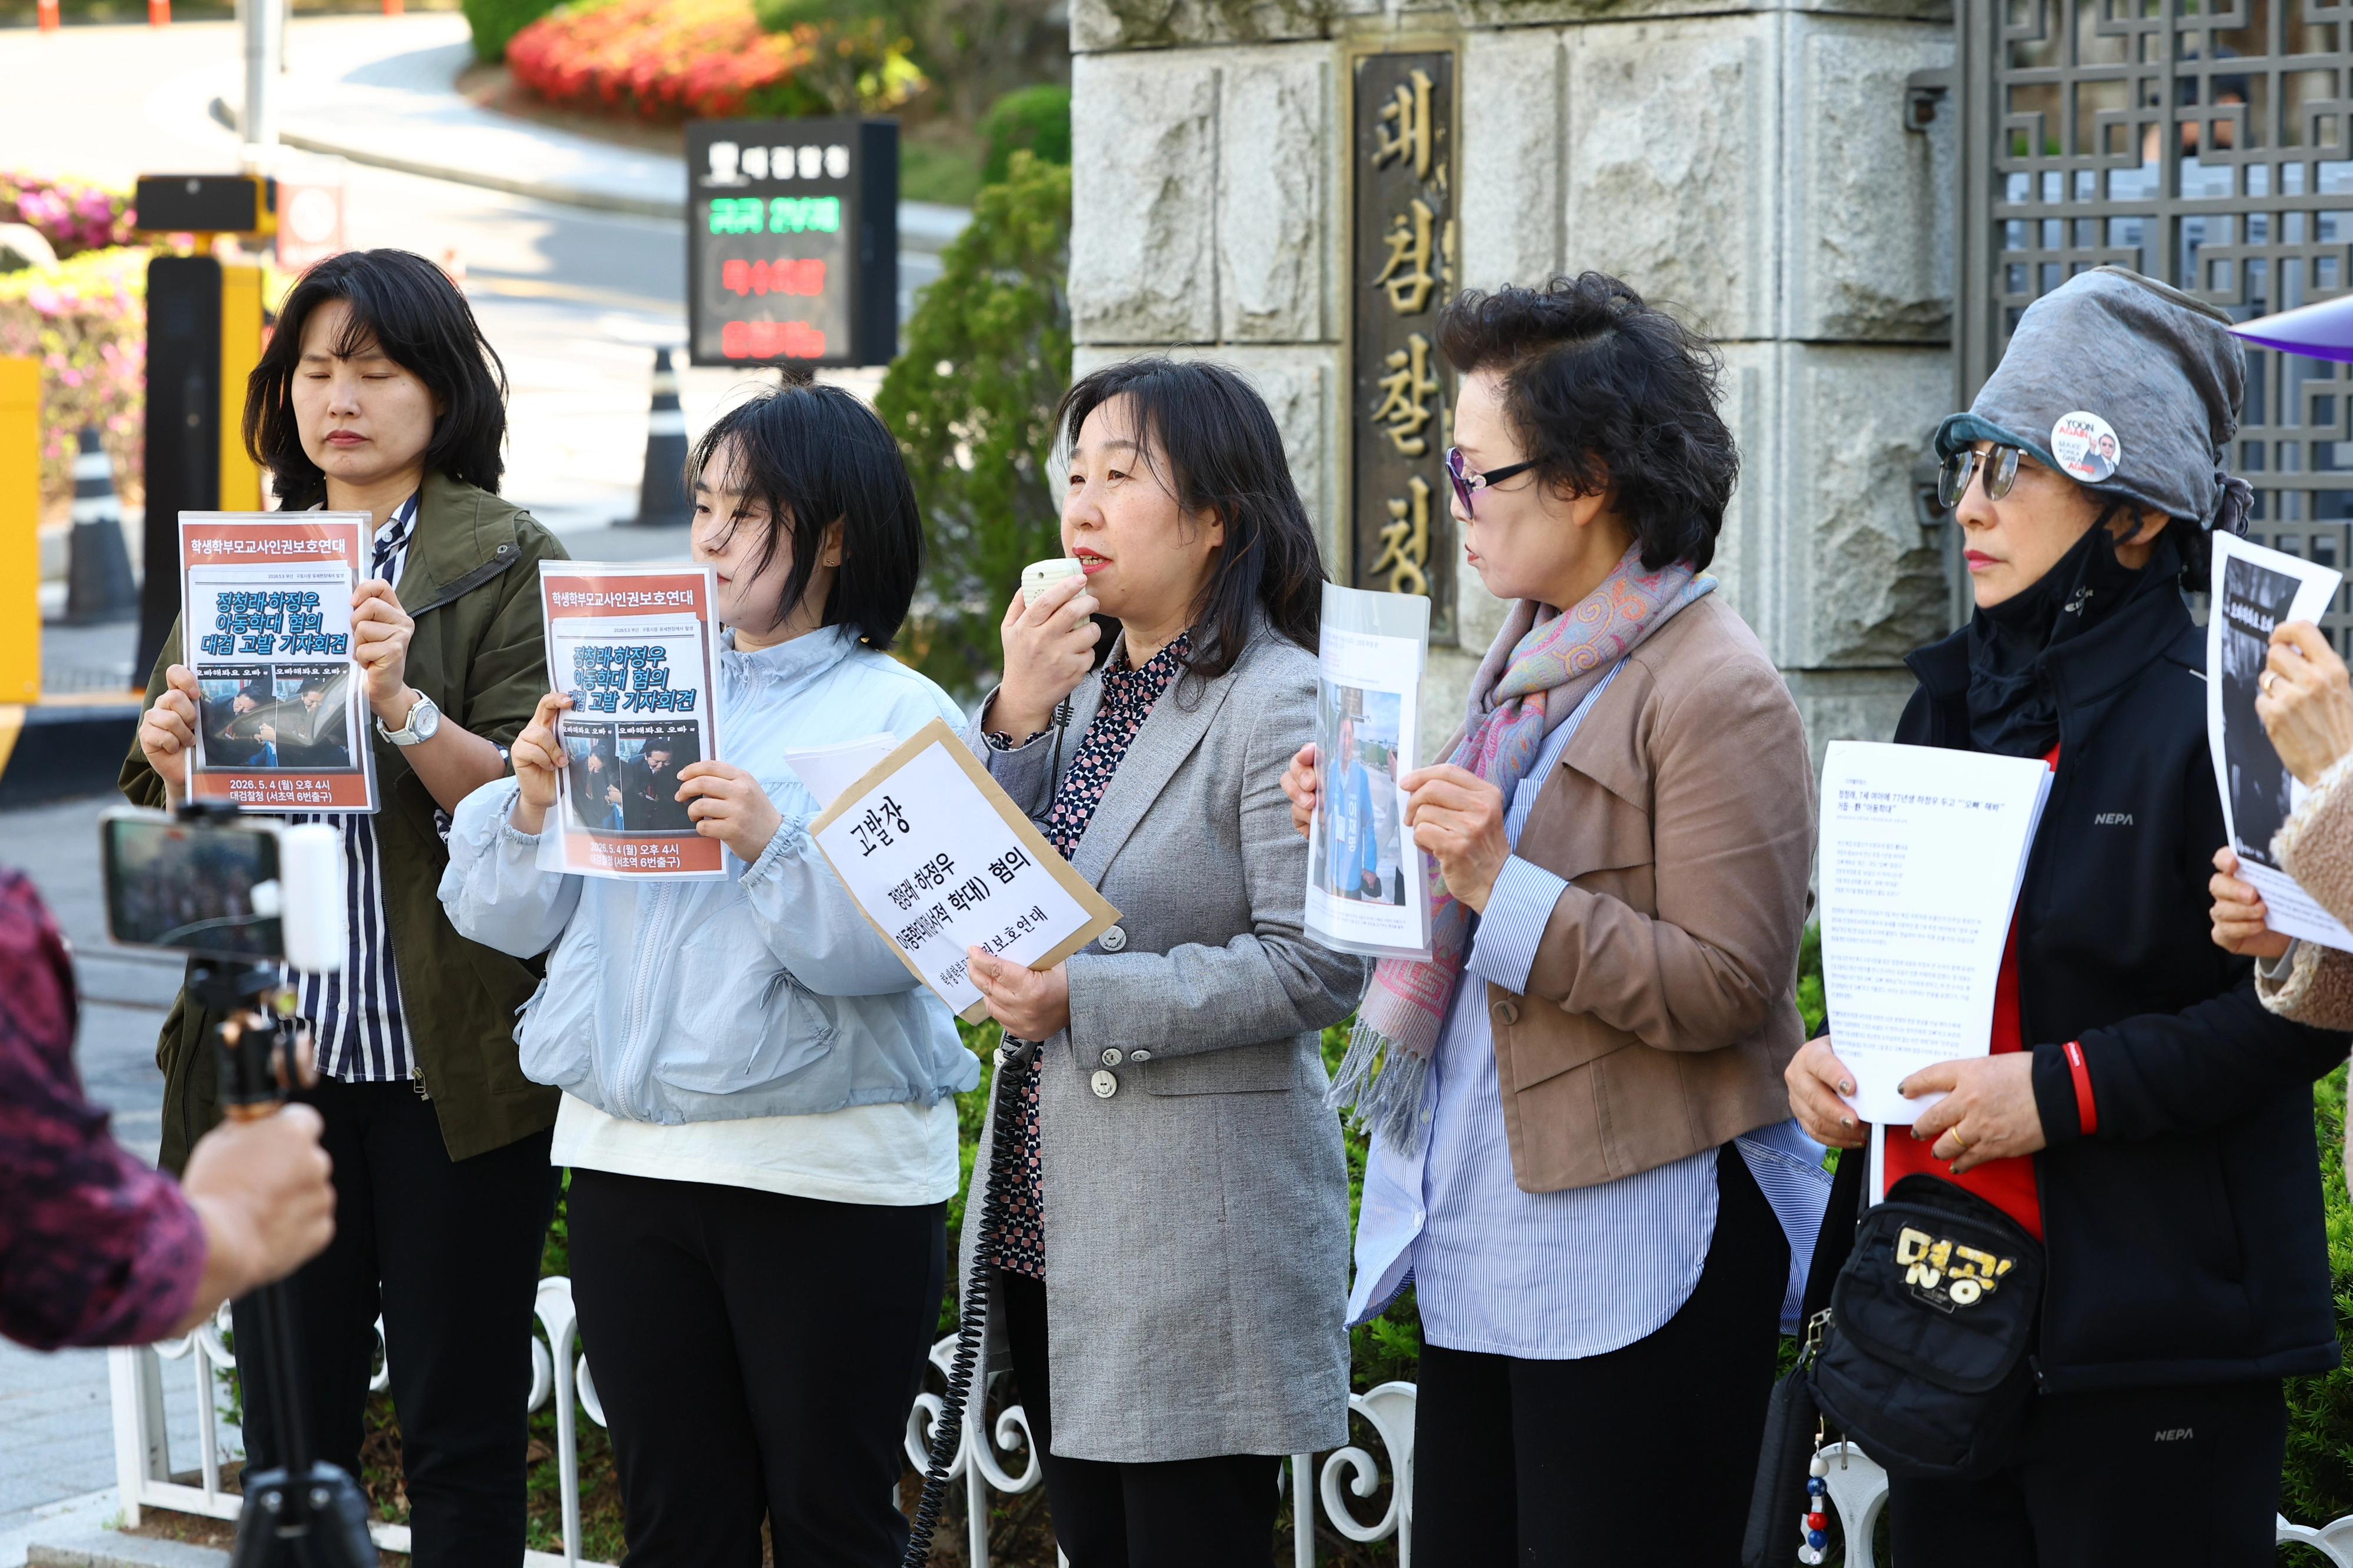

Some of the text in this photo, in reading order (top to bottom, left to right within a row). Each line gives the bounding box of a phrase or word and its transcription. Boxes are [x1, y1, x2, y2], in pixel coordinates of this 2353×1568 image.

[1369, 67, 1438, 595] 대검찰청
[2059, 426, 2088, 439] AGAIN
[2066, 419, 2094, 432] YOON
[191, 538, 346, 555] 학생학부모교사인권보호연대
[552, 589, 694, 608] 학생학부모교사인권보호연대
[215, 612, 323, 634] 아동학대 혐의
[201, 633, 348, 655] 대검 고발 기자회견
[196, 669, 240, 677] 오빠해봐요
[275, 668, 320, 676] 오빠해봐요
[322, 667, 341, 675] 오빠
[574, 667, 669, 691] 아동학대 혐의
[568, 689, 696, 713] 대검 고발 기자회견
[563, 726, 590, 734] 오빠해봐요
[618, 725, 664, 734] 오빠해봐요
[666, 725, 687, 733] 오빠
[278, 779, 294, 791] (월)
[295, 780, 313, 790] 오후
[315, 779, 330, 790] 4시
[229, 791, 332, 803] 대검찰청 (서초역 6번출구)
[1859, 791, 1869, 800] 7세
[1871, 792, 1890, 802] 여아에
[1892, 793, 1915, 804] 77년생
[1917, 795, 1938, 806] 하정우
[1941, 797, 1955, 808] 두고
[849, 795, 910, 857] 고발장
[1348, 800, 1357, 853] 이재명
[2094, 813, 2133, 825] NEPA
[623, 845, 637, 856] (월)
[640, 844, 659, 856] 오후
[661, 843, 679, 855] 4시
[590, 855, 681, 868] 대검찰청 (서초역 6번출구)
[896, 846, 1032, 952] 아동학대(정서적 학대) 혐의
[2154, 1427, 2194, 1442] NEPA
